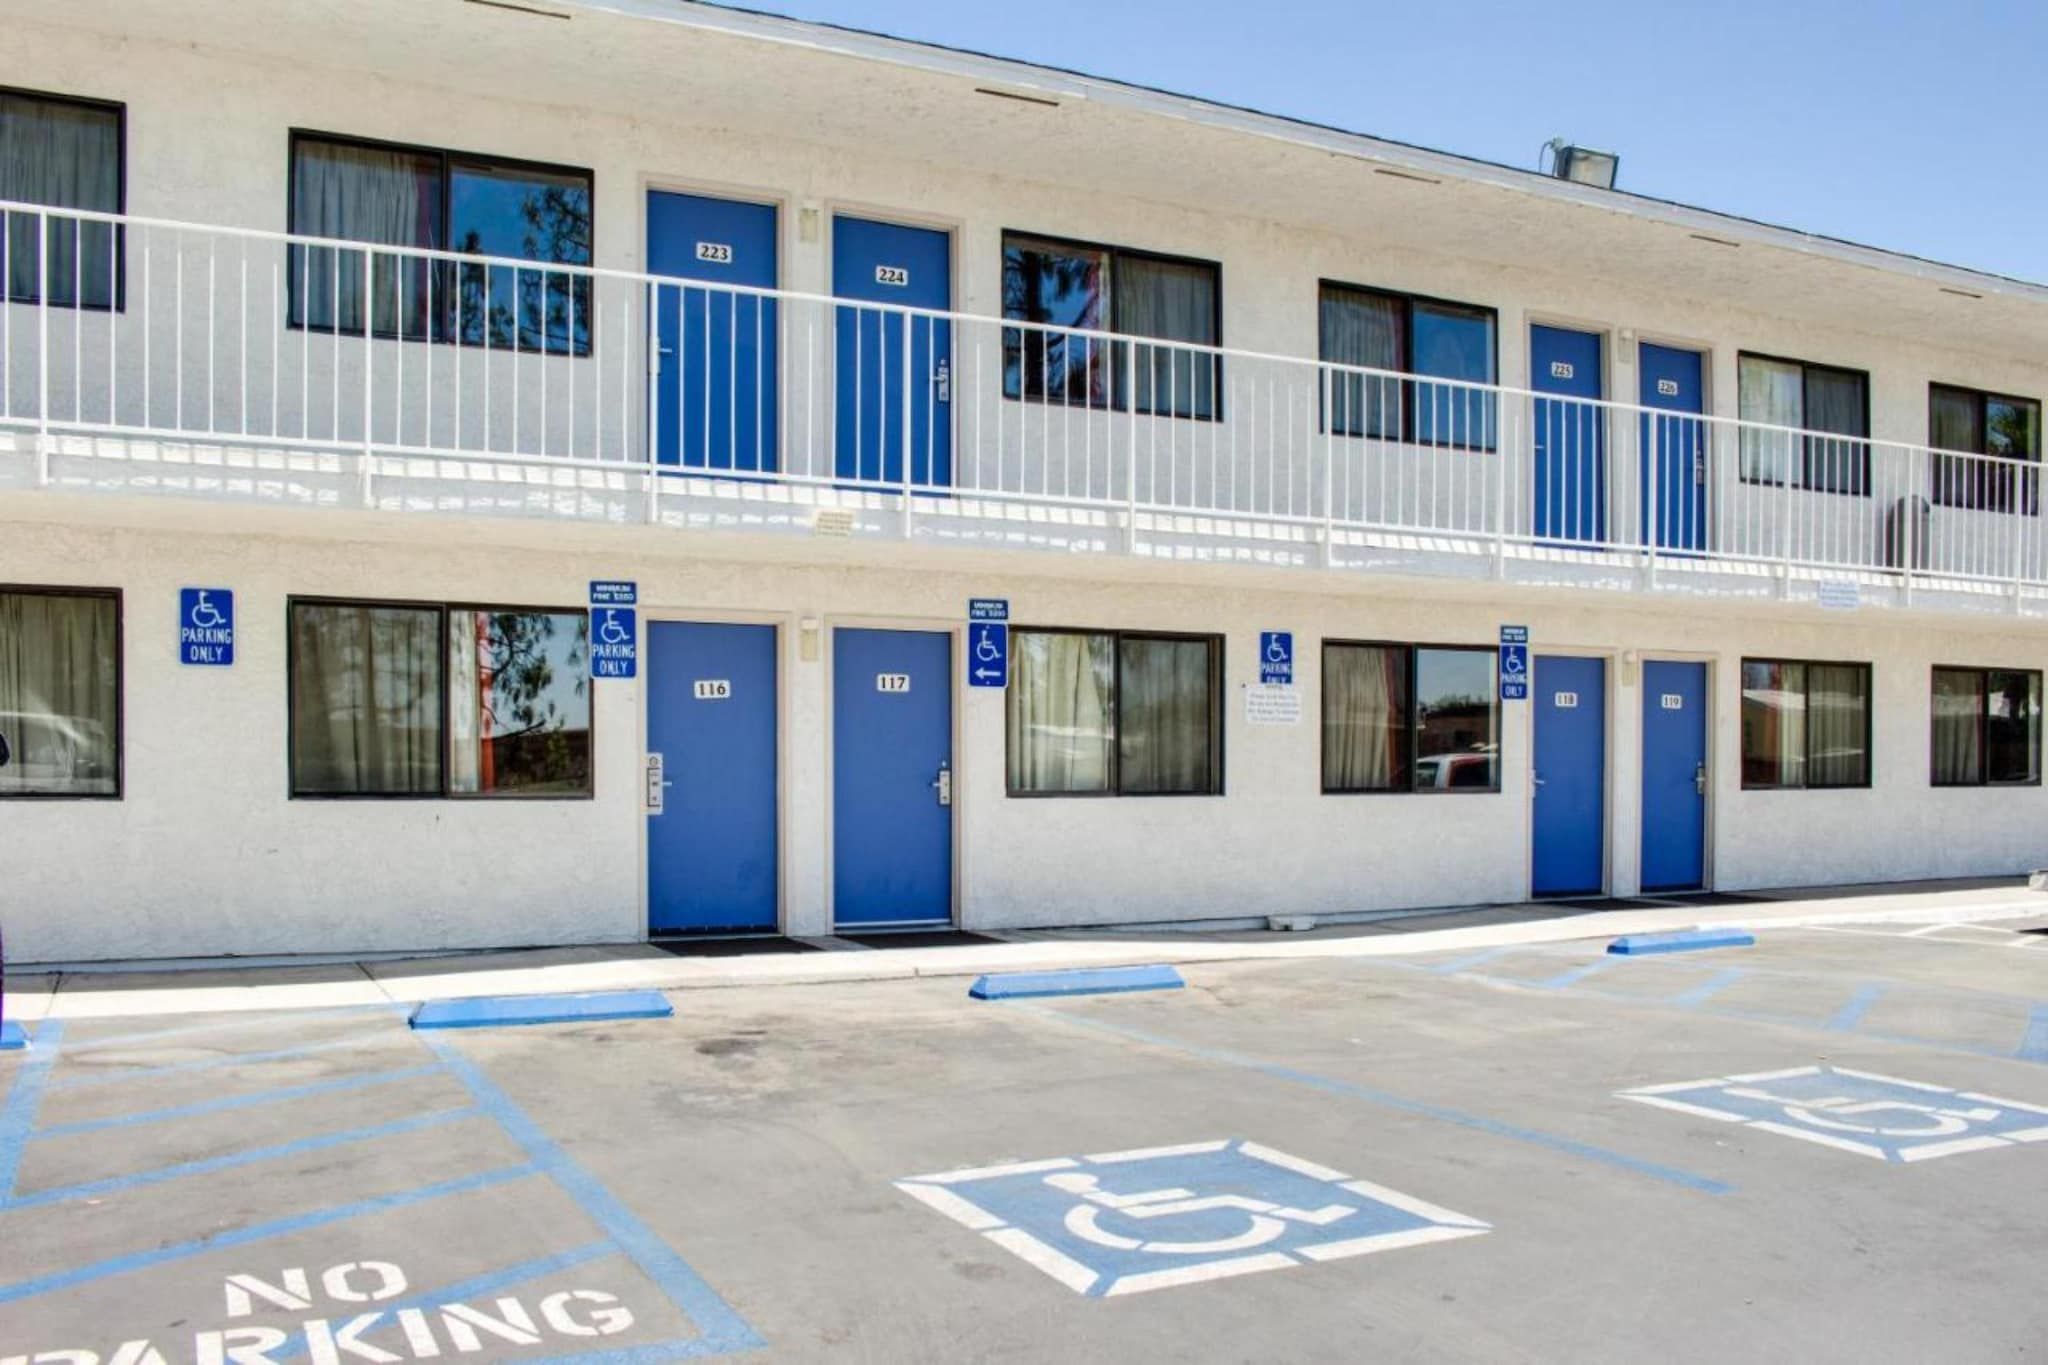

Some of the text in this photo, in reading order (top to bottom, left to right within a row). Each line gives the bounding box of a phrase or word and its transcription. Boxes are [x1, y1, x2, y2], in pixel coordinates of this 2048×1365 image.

[701, 245, 729, 261] 223
[879, 268, 905, 283] 224
[1554, 365, 1571, 376] 225
[182, 627, 231, 644] PARKING
[190, 645, 223, 662] ONLY
[593, 643, 634, 659] PARKING
[600, 660, 628, 675] ONLY
[1261, 661, 1291, 674] PARKING
[700, 683, 726, 696] 116
[882, 676, 905, 689] 117
[1505, 685, 1523, 697] ONLY
[225, 1261, 408, 1316] NO
